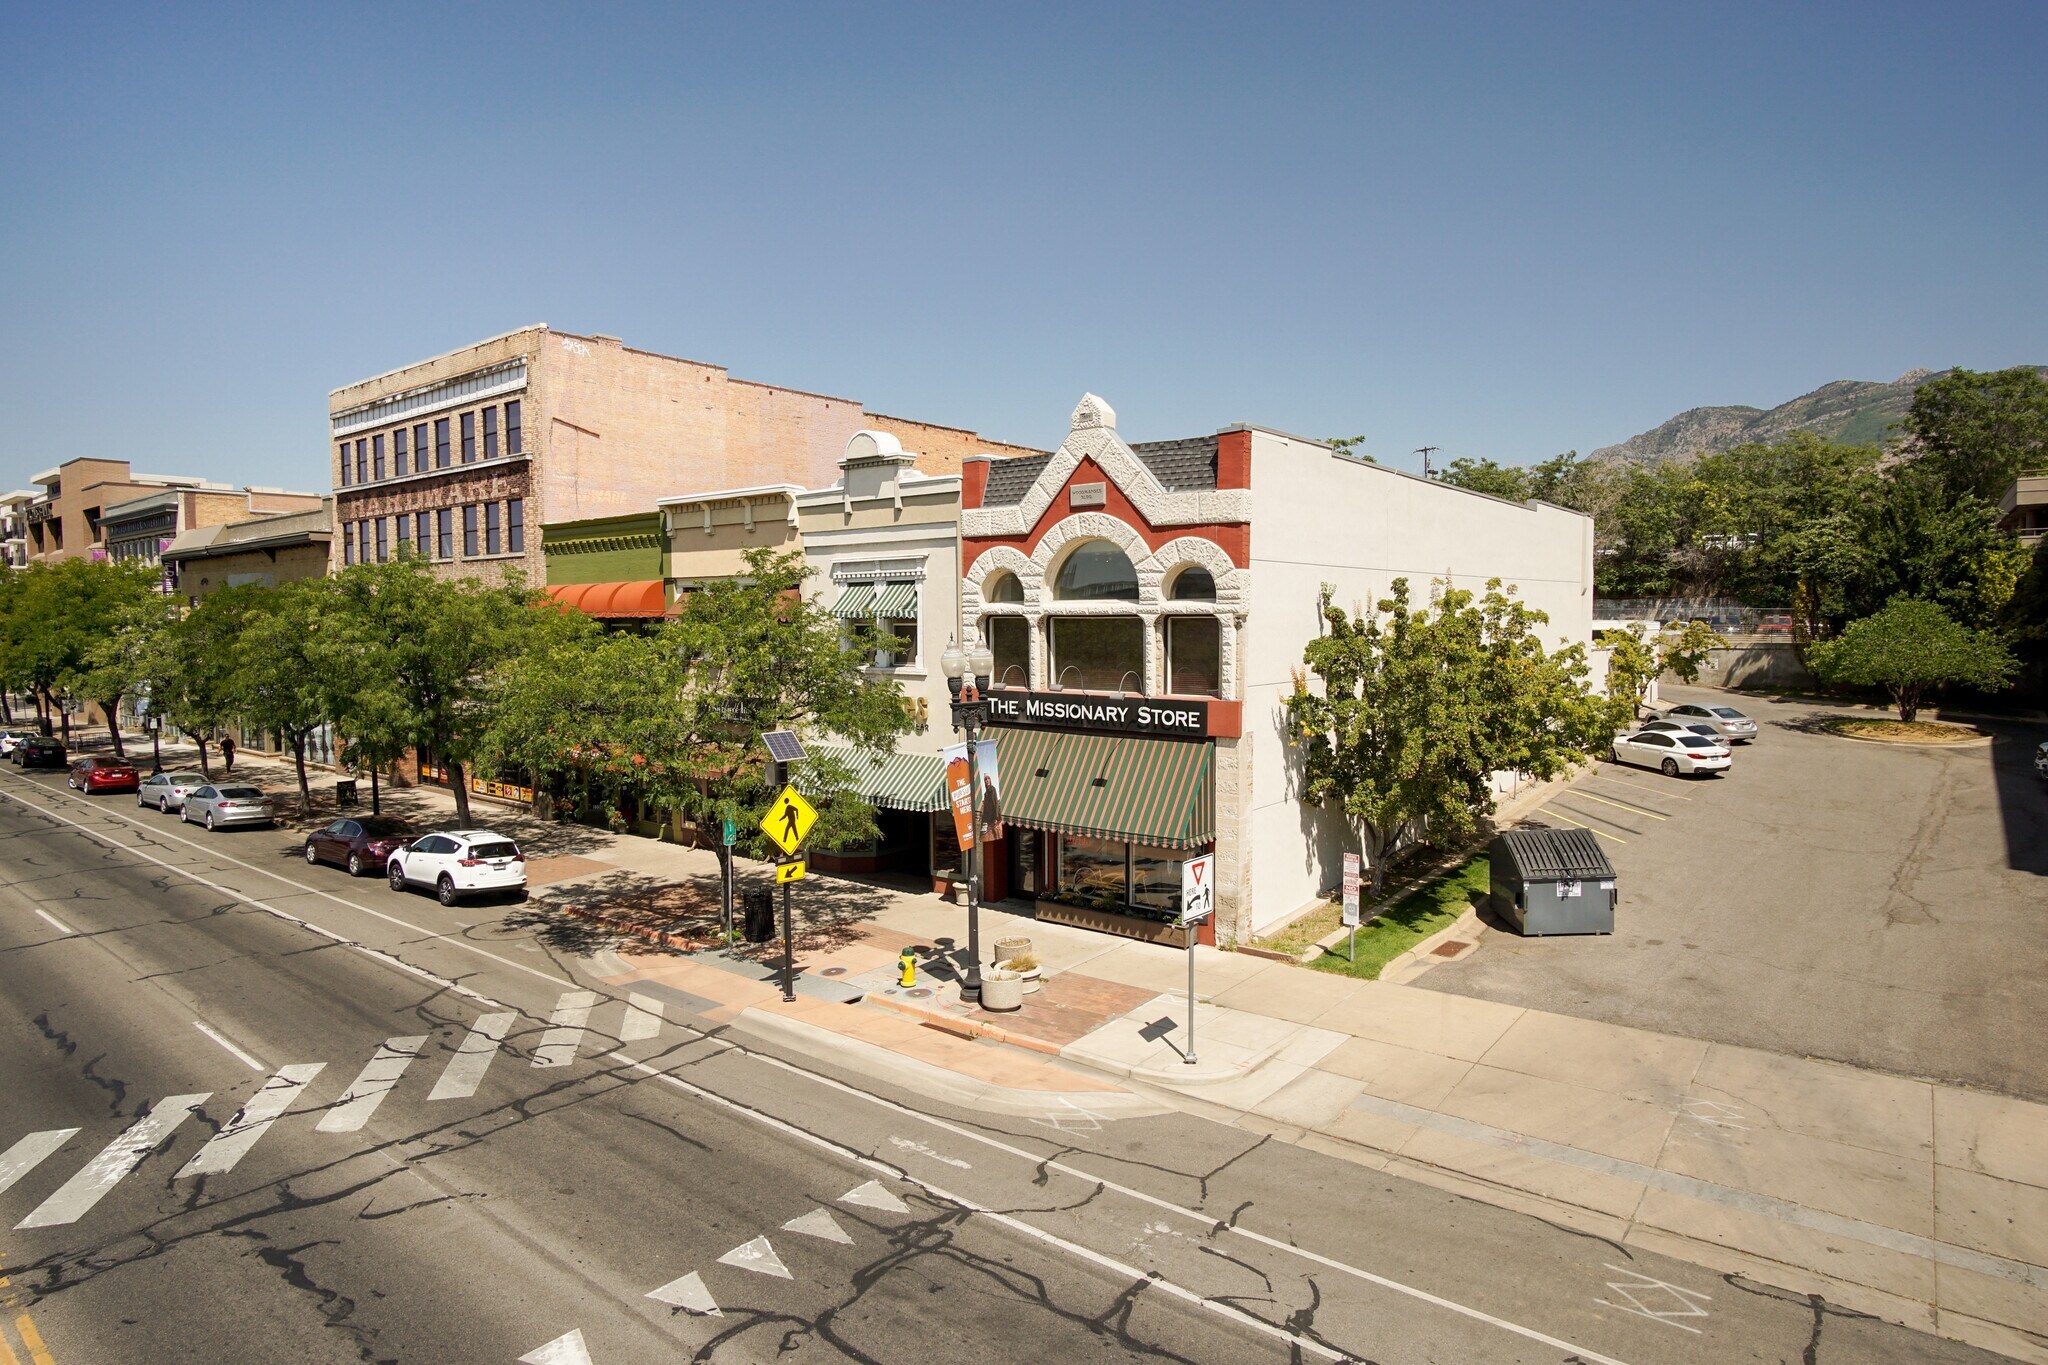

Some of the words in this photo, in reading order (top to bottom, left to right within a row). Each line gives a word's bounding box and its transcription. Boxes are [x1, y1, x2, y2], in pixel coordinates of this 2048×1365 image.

[987, 697, 1019, 715] THE
[1026, 699, 1129, 722] MISSIONARY
[1137, 706, 1200, 728] STORE
[955, 777, 967, 788] THE
[959, 804, 972, 815] HERE
[1185, 886, 1197, 897] HERE
